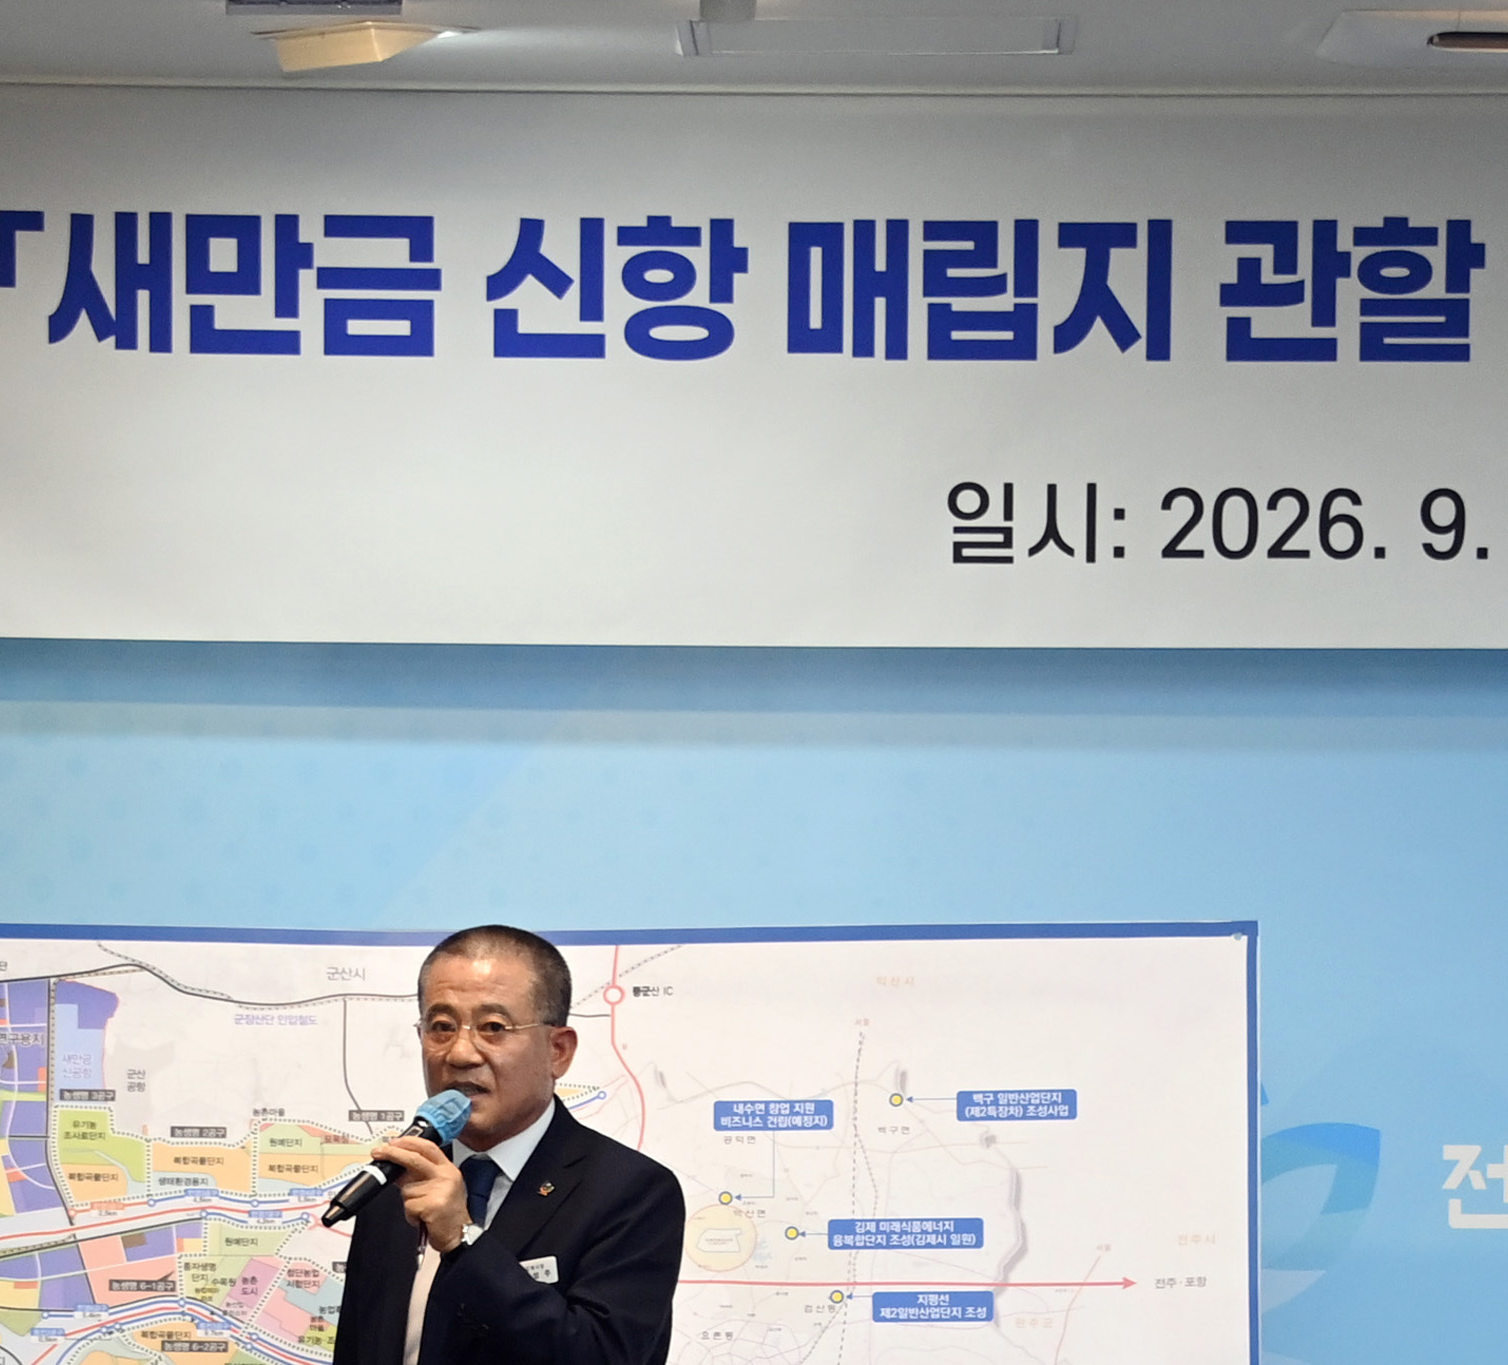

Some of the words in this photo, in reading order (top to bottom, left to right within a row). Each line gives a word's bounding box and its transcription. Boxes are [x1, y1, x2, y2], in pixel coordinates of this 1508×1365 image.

[486, 216, 749, 361] 신항
[787, 217, 1173, 362] 매립지
[1219, 215, 1485, 363] 관할
[947, 480, 1128, 566] 일시:
[1158, 484, 1388, 562] 2026.
[1418, 484, 1490, 562] 9.
[326, 966, 366, 981] 군산시
[663, 985, 674, 997] IC
[126, 1068, 146, 1080] 군산
[126, 1081, 146, 1093] 공항
[972, 1092, 995, 1105] 백구
[997, 1091, 1062, 1104] 일반산업단지
[768, 1102, 790, 1115] 창업
[793, 1102, 815, 1114] 지원
[1026, 1104, 1070, 1118] 조성사업
[720, 1115, 764, 1128] 비즈니스
[767, 1115, 829, 1128] 건립(예정지)
[854, 1221, 877, 1234] 김제
[879, 1220, 954, 1233] 미래식품에너지
[889, 1233, 947, 1247] 조성(김제시
[950, 1233, 976, 1246] 일원)
[191, 1273, 209, 1283] 단지
[1155, 1277, 1177, 1289] 전주
[1184, 1276, 1207, 1288] 포항
[241, 1287, 258, 1297] 도시
[917, 1294, 950, 1305] 지평선
[879, 1306, 962, 1320] 제2일반산업단지
[965, 1306, 988, 1319] 조성
